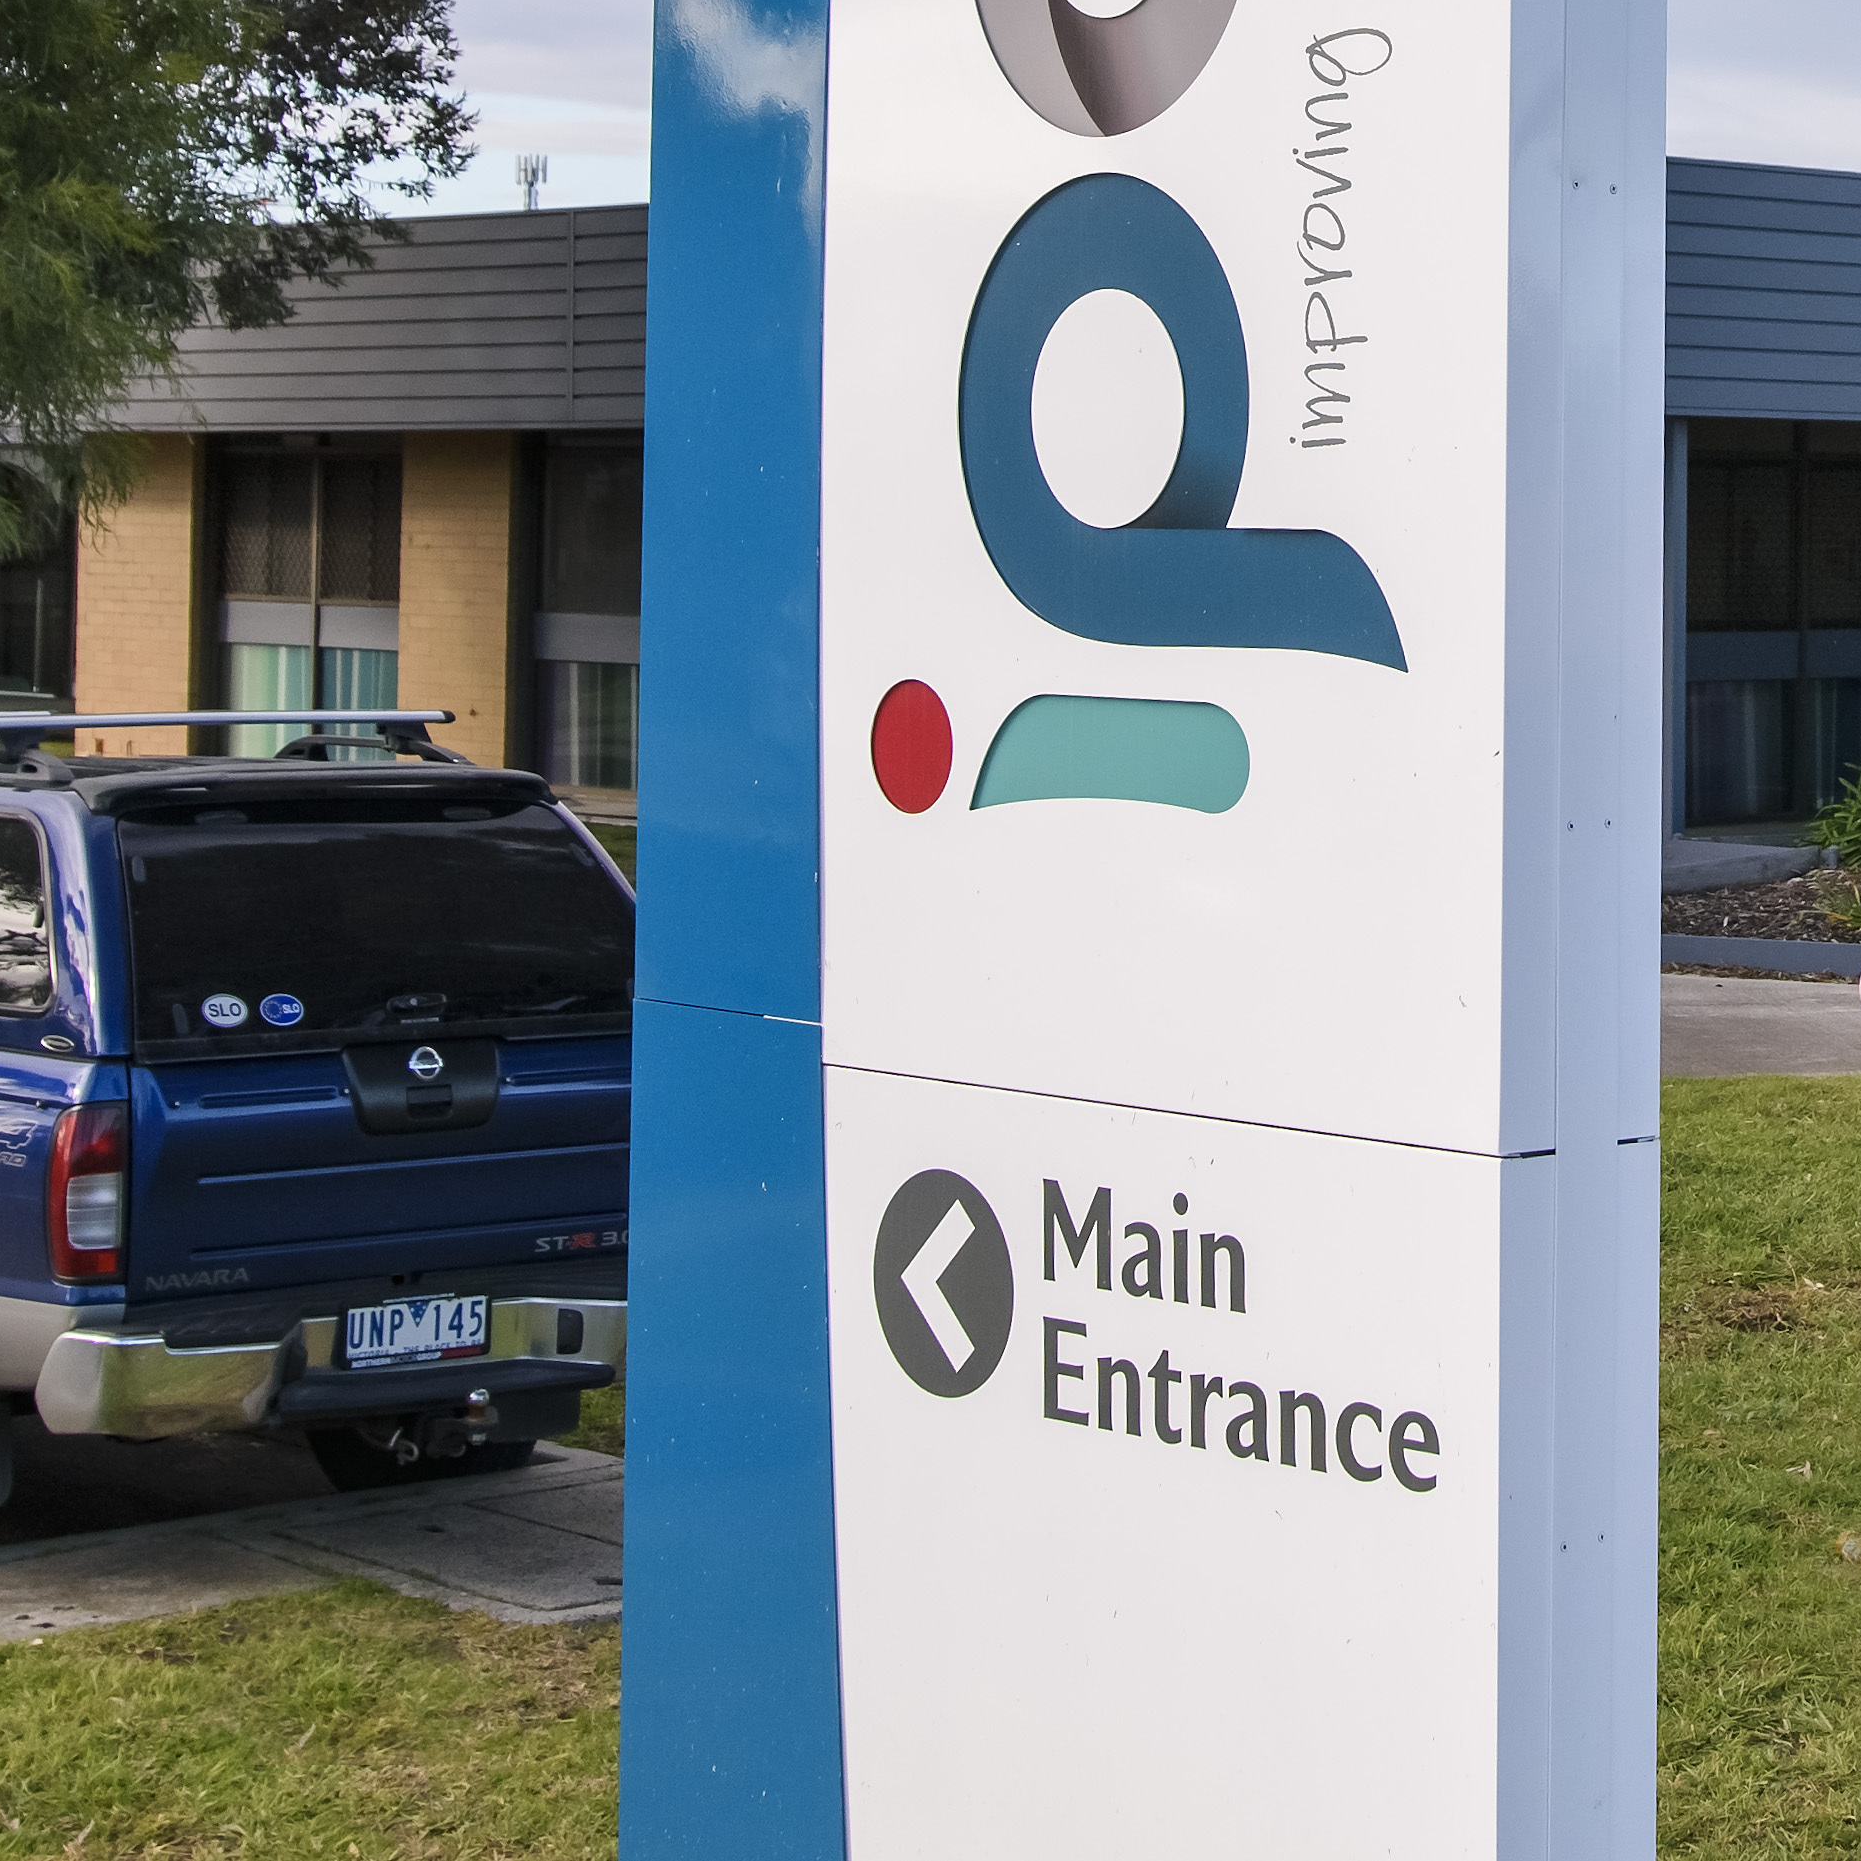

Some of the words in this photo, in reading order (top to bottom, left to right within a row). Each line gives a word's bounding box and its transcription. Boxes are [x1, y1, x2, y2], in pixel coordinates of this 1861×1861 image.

[1289, 27, 1392, 449] improving
[207, 1002, 242, 1018] SLO
[282, 1002, 300, 1015] SLO
[1042, 1178, 1247, 1314] Main
[145, 1267, 250, 1291] NAVARA
[349, 1308, 404, 1349] UNP
[433, 1299, 484, 1342] 145
[1042, 1315, 1441, 1493] Entrance
